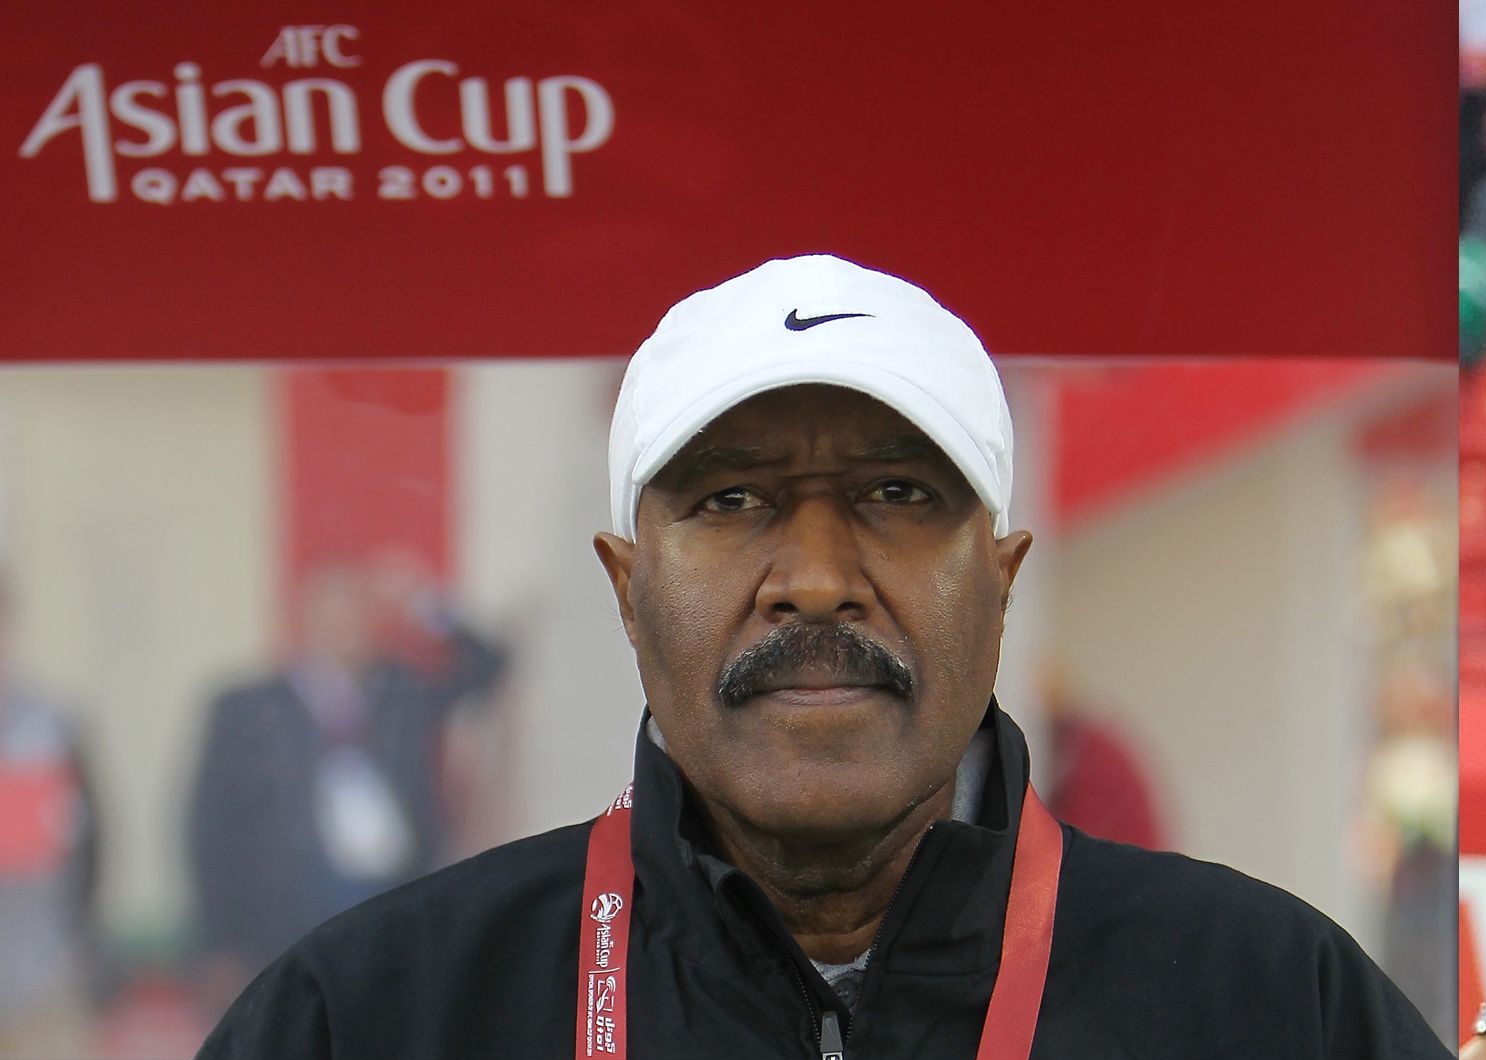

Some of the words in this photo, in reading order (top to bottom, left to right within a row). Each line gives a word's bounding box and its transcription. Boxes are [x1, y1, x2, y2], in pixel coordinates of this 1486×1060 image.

[260, 24, 363, 68] AFC
[18, 61, 362, 202] Asian
[382, 59, 614, 197] Cup
[131, 167, 354, 204] QATAR
[378, 165, 529, 199] 2011
